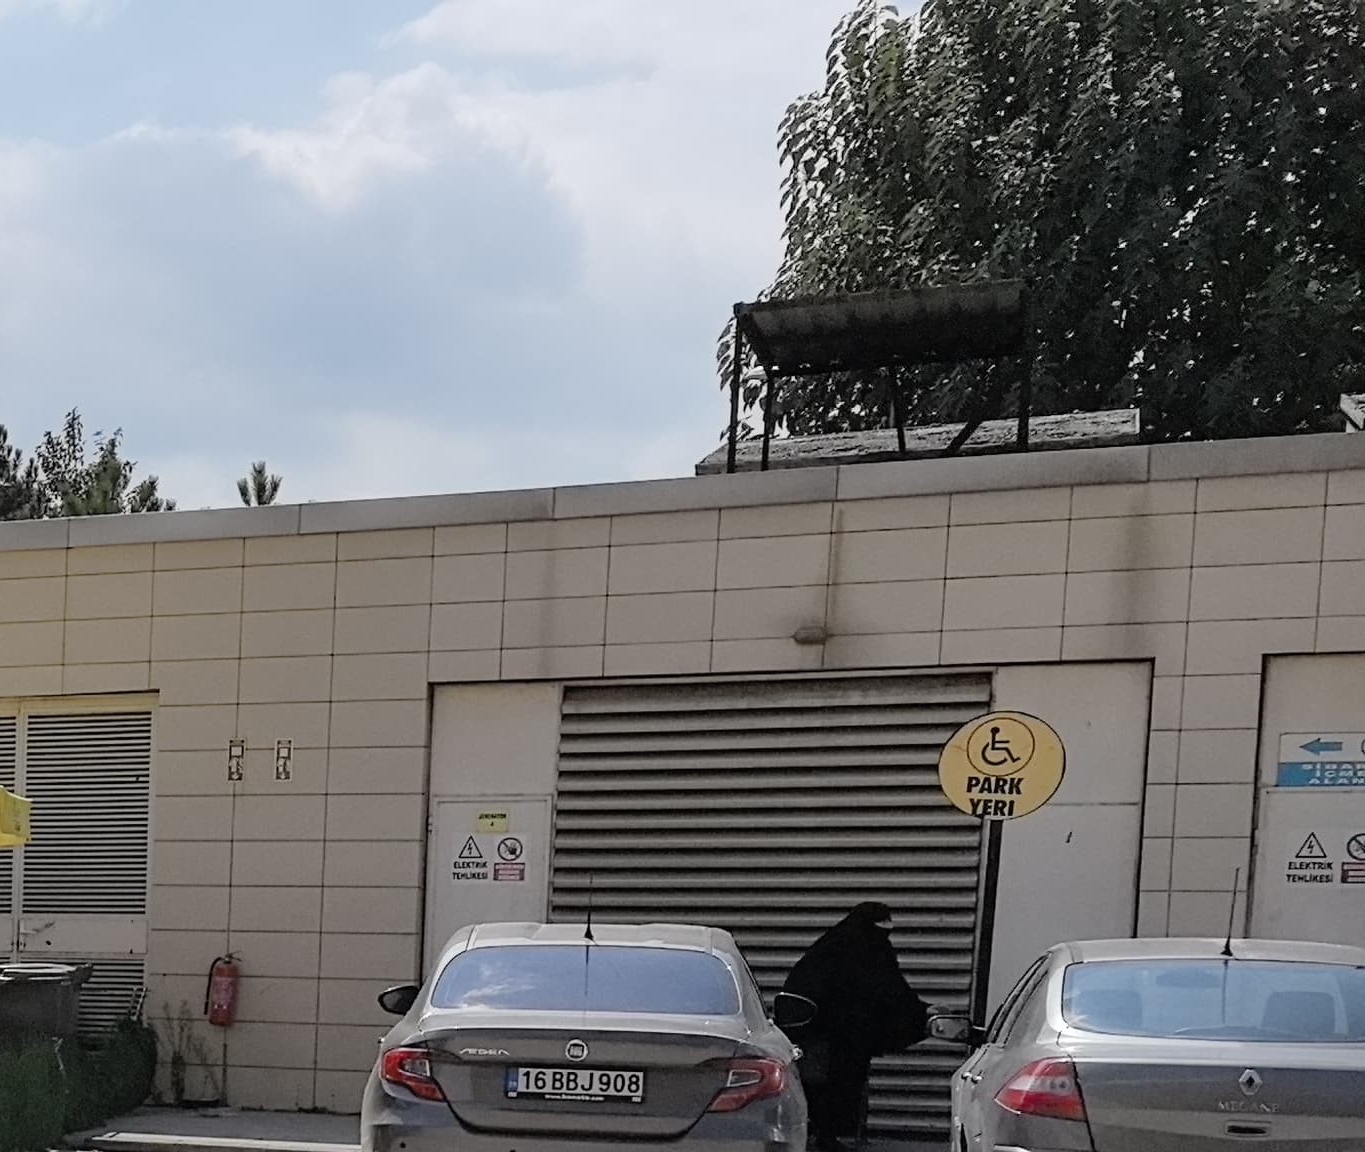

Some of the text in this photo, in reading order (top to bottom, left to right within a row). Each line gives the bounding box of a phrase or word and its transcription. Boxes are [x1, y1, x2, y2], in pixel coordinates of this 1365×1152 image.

[966, 776, 1024, 795] PARK
[969, 798, 1015, 816] YERI
[522, 1070, 641, 1093] 16 BBJ 908
